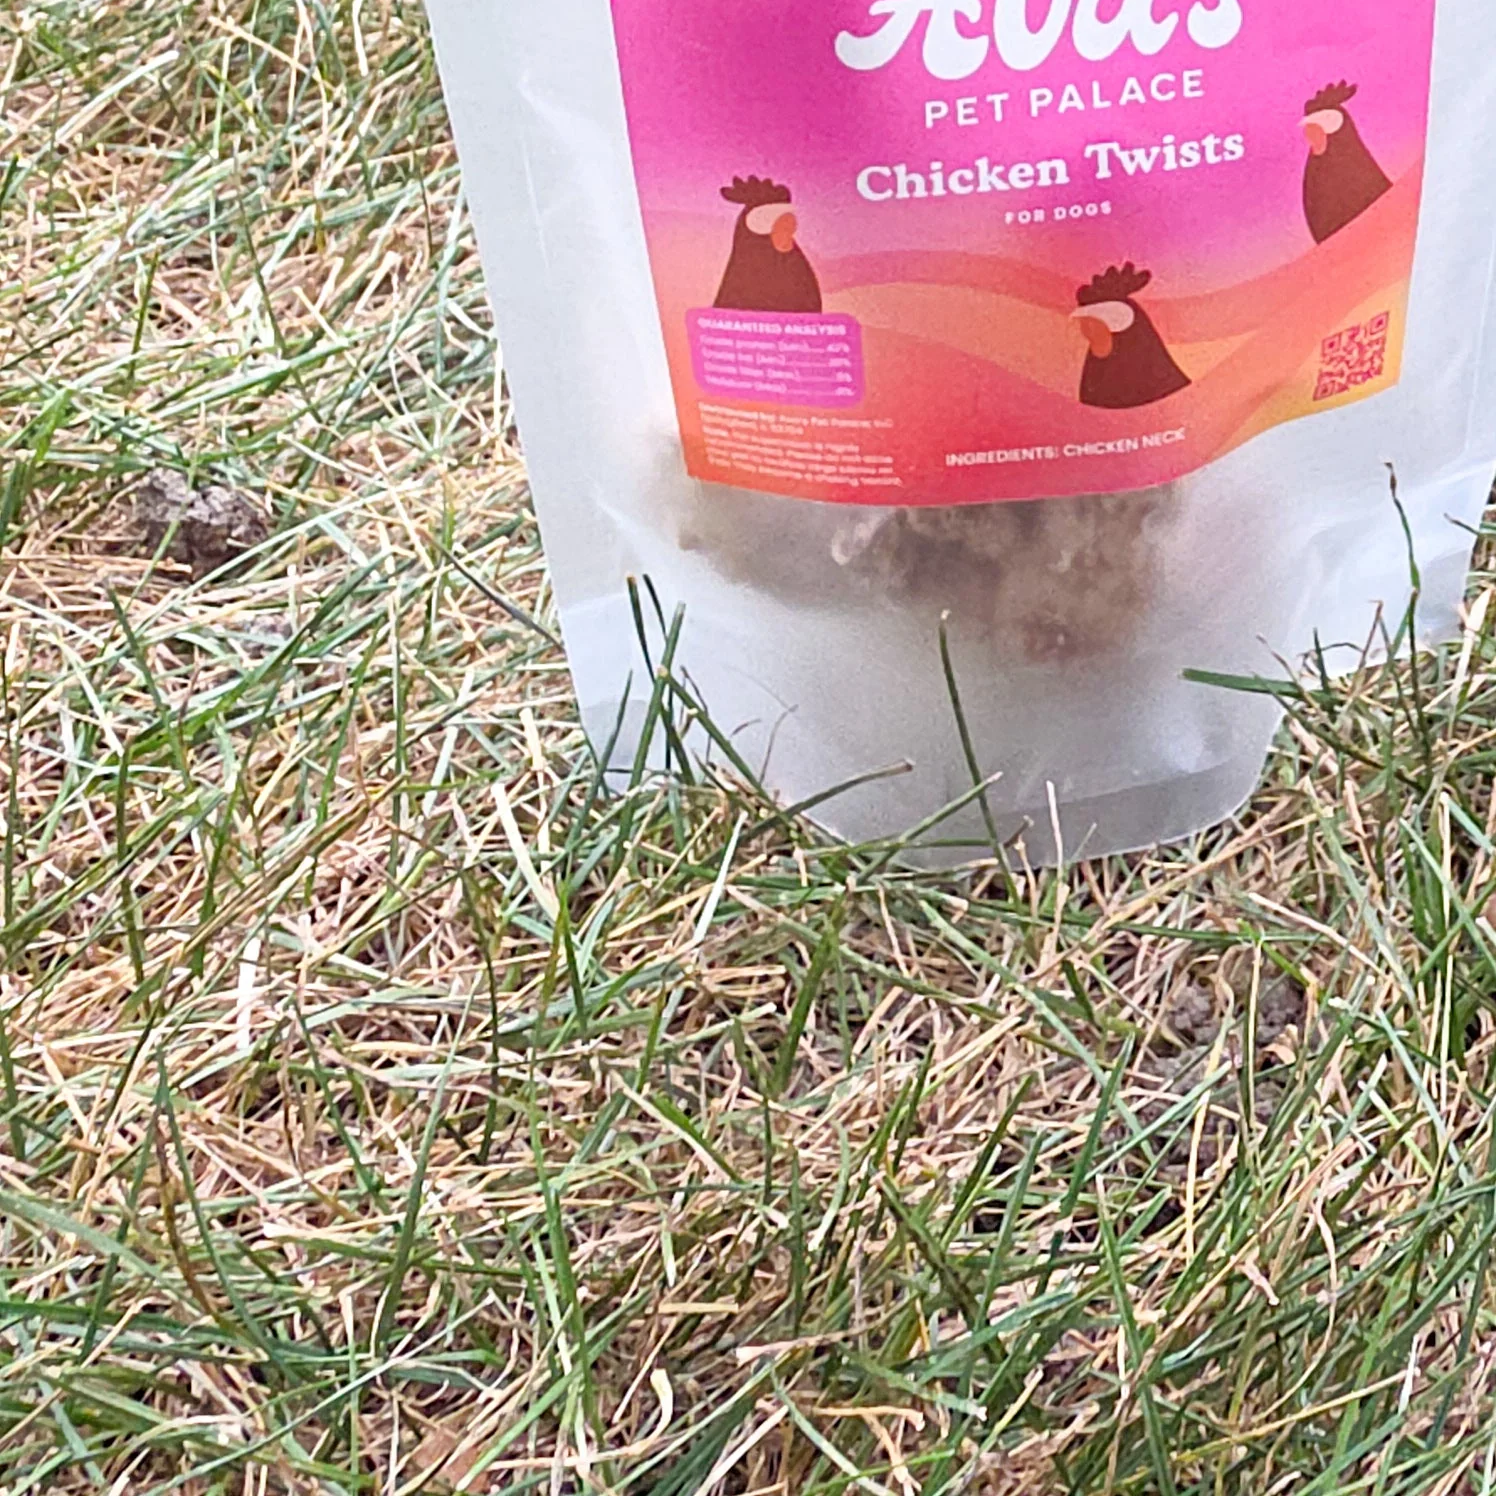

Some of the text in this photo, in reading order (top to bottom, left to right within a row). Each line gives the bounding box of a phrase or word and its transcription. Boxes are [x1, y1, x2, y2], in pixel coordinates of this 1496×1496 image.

[924, 69, 1205, 129] PET PALACE
[856, 133, 1245, 202] Chicken Twists
[1004, 200, 1112, 225] FOR DOGS
[945, 427, 1187, 466] INGREDIENTS: CHICKEN NECK
